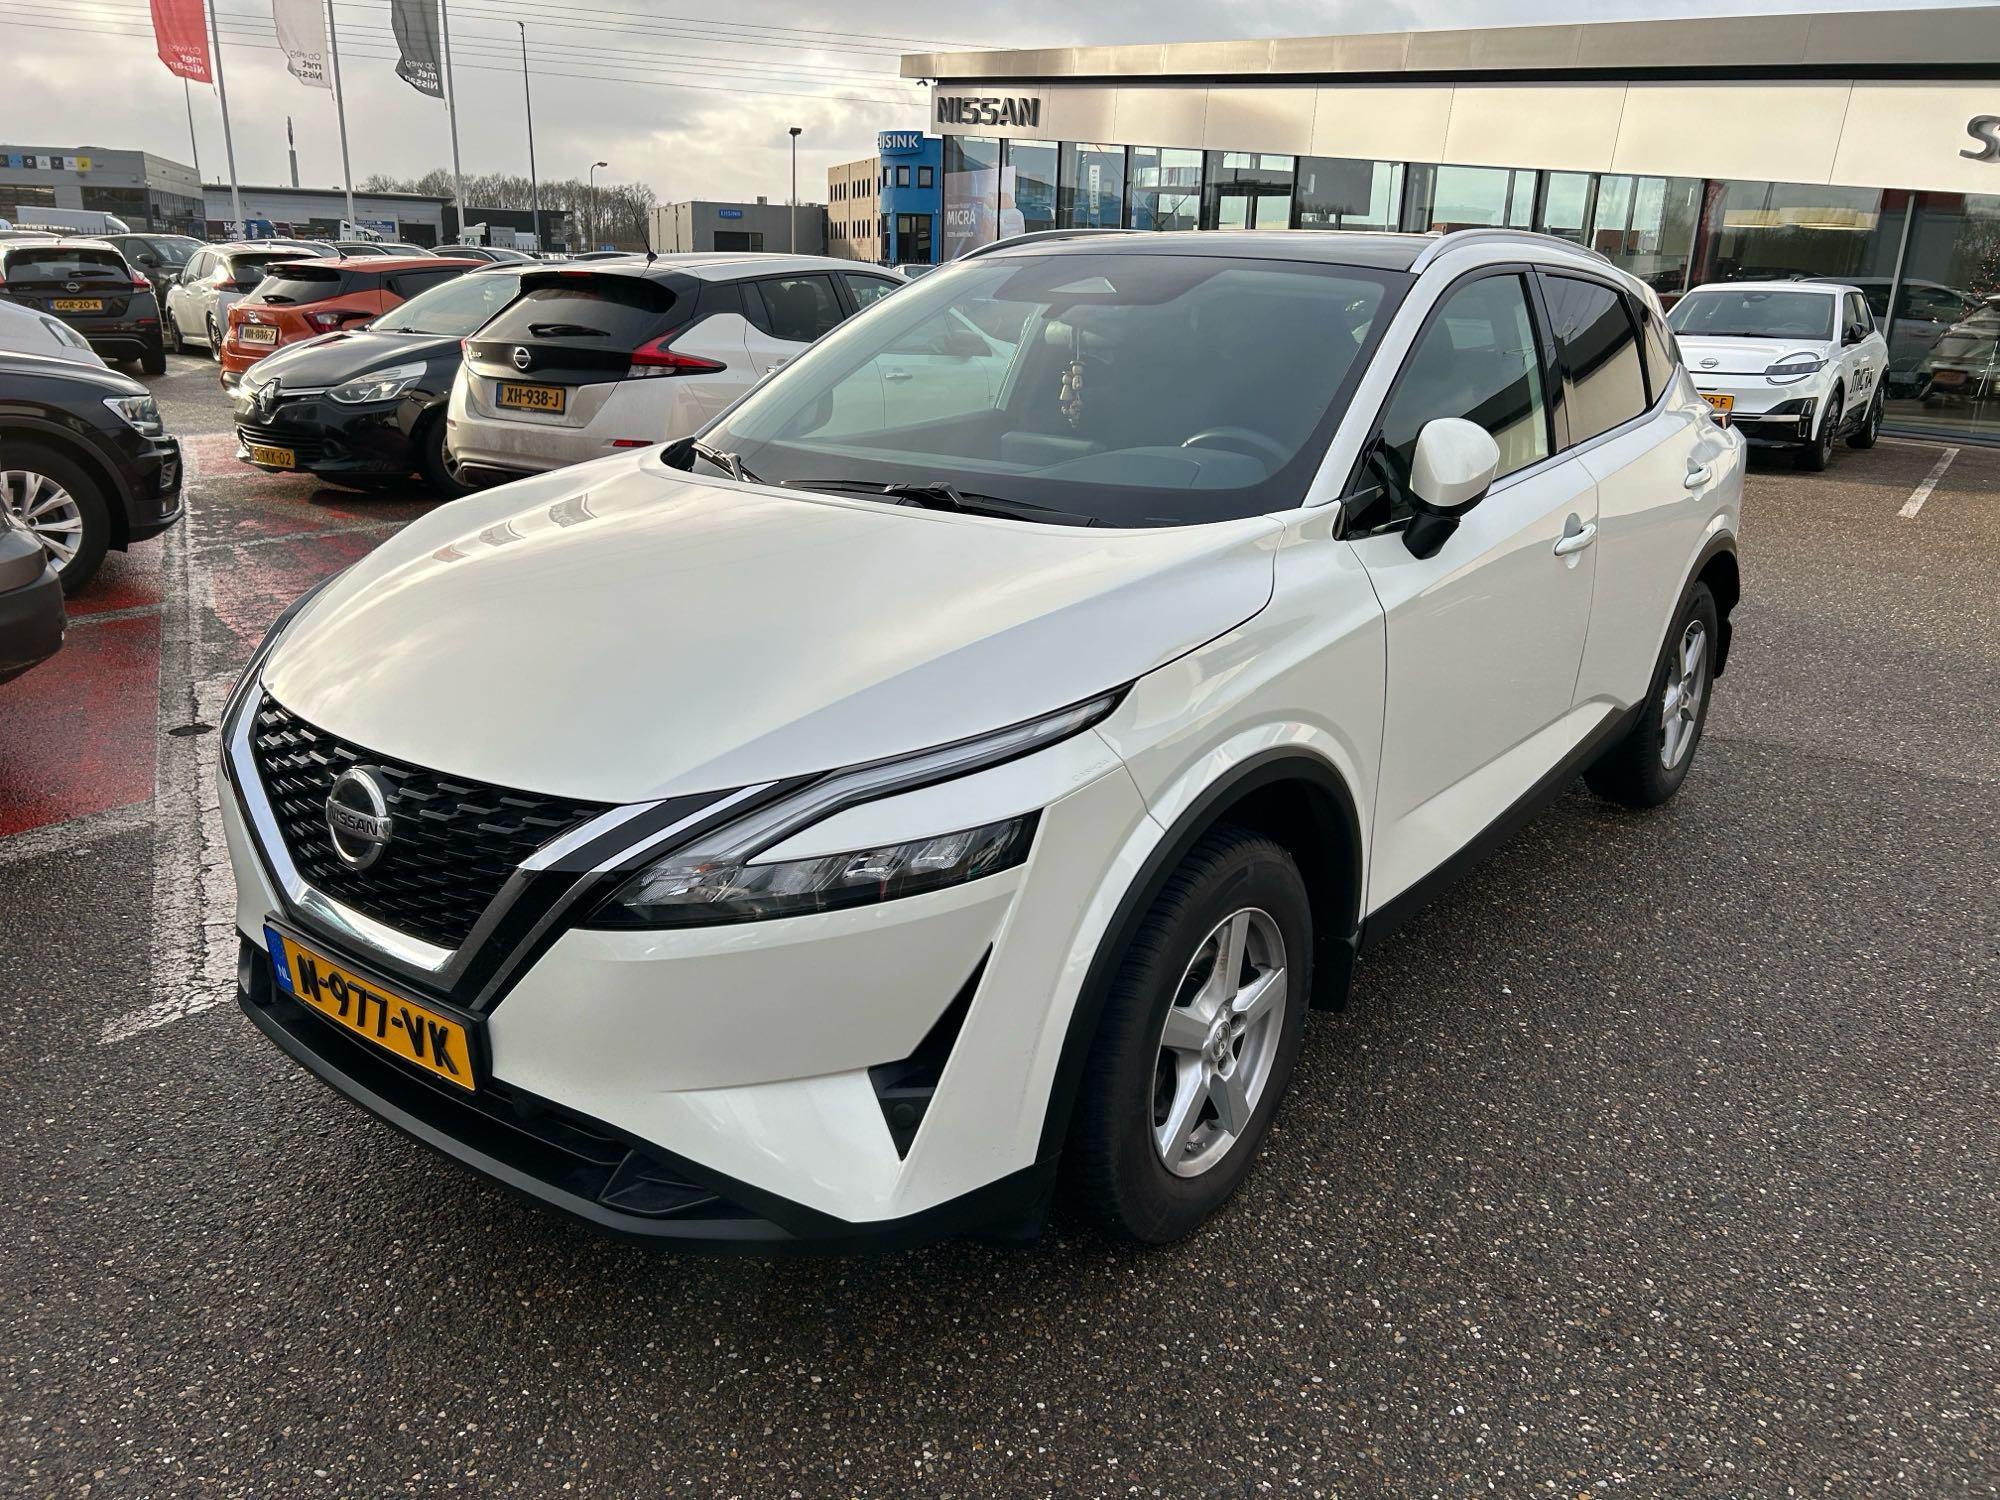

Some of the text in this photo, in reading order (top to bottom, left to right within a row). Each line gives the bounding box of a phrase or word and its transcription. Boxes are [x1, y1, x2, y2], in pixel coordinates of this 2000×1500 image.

[937, 96, 1041, 128] NISSAN
[946, 210, 976, 225] MICRA
[506, 387, 559, 408] XH-938-J
[330, 805, 378, 836] NISSAN
[277, 964, 291, 983] NL
[296, 952, 460, 1076] N-977-VK
